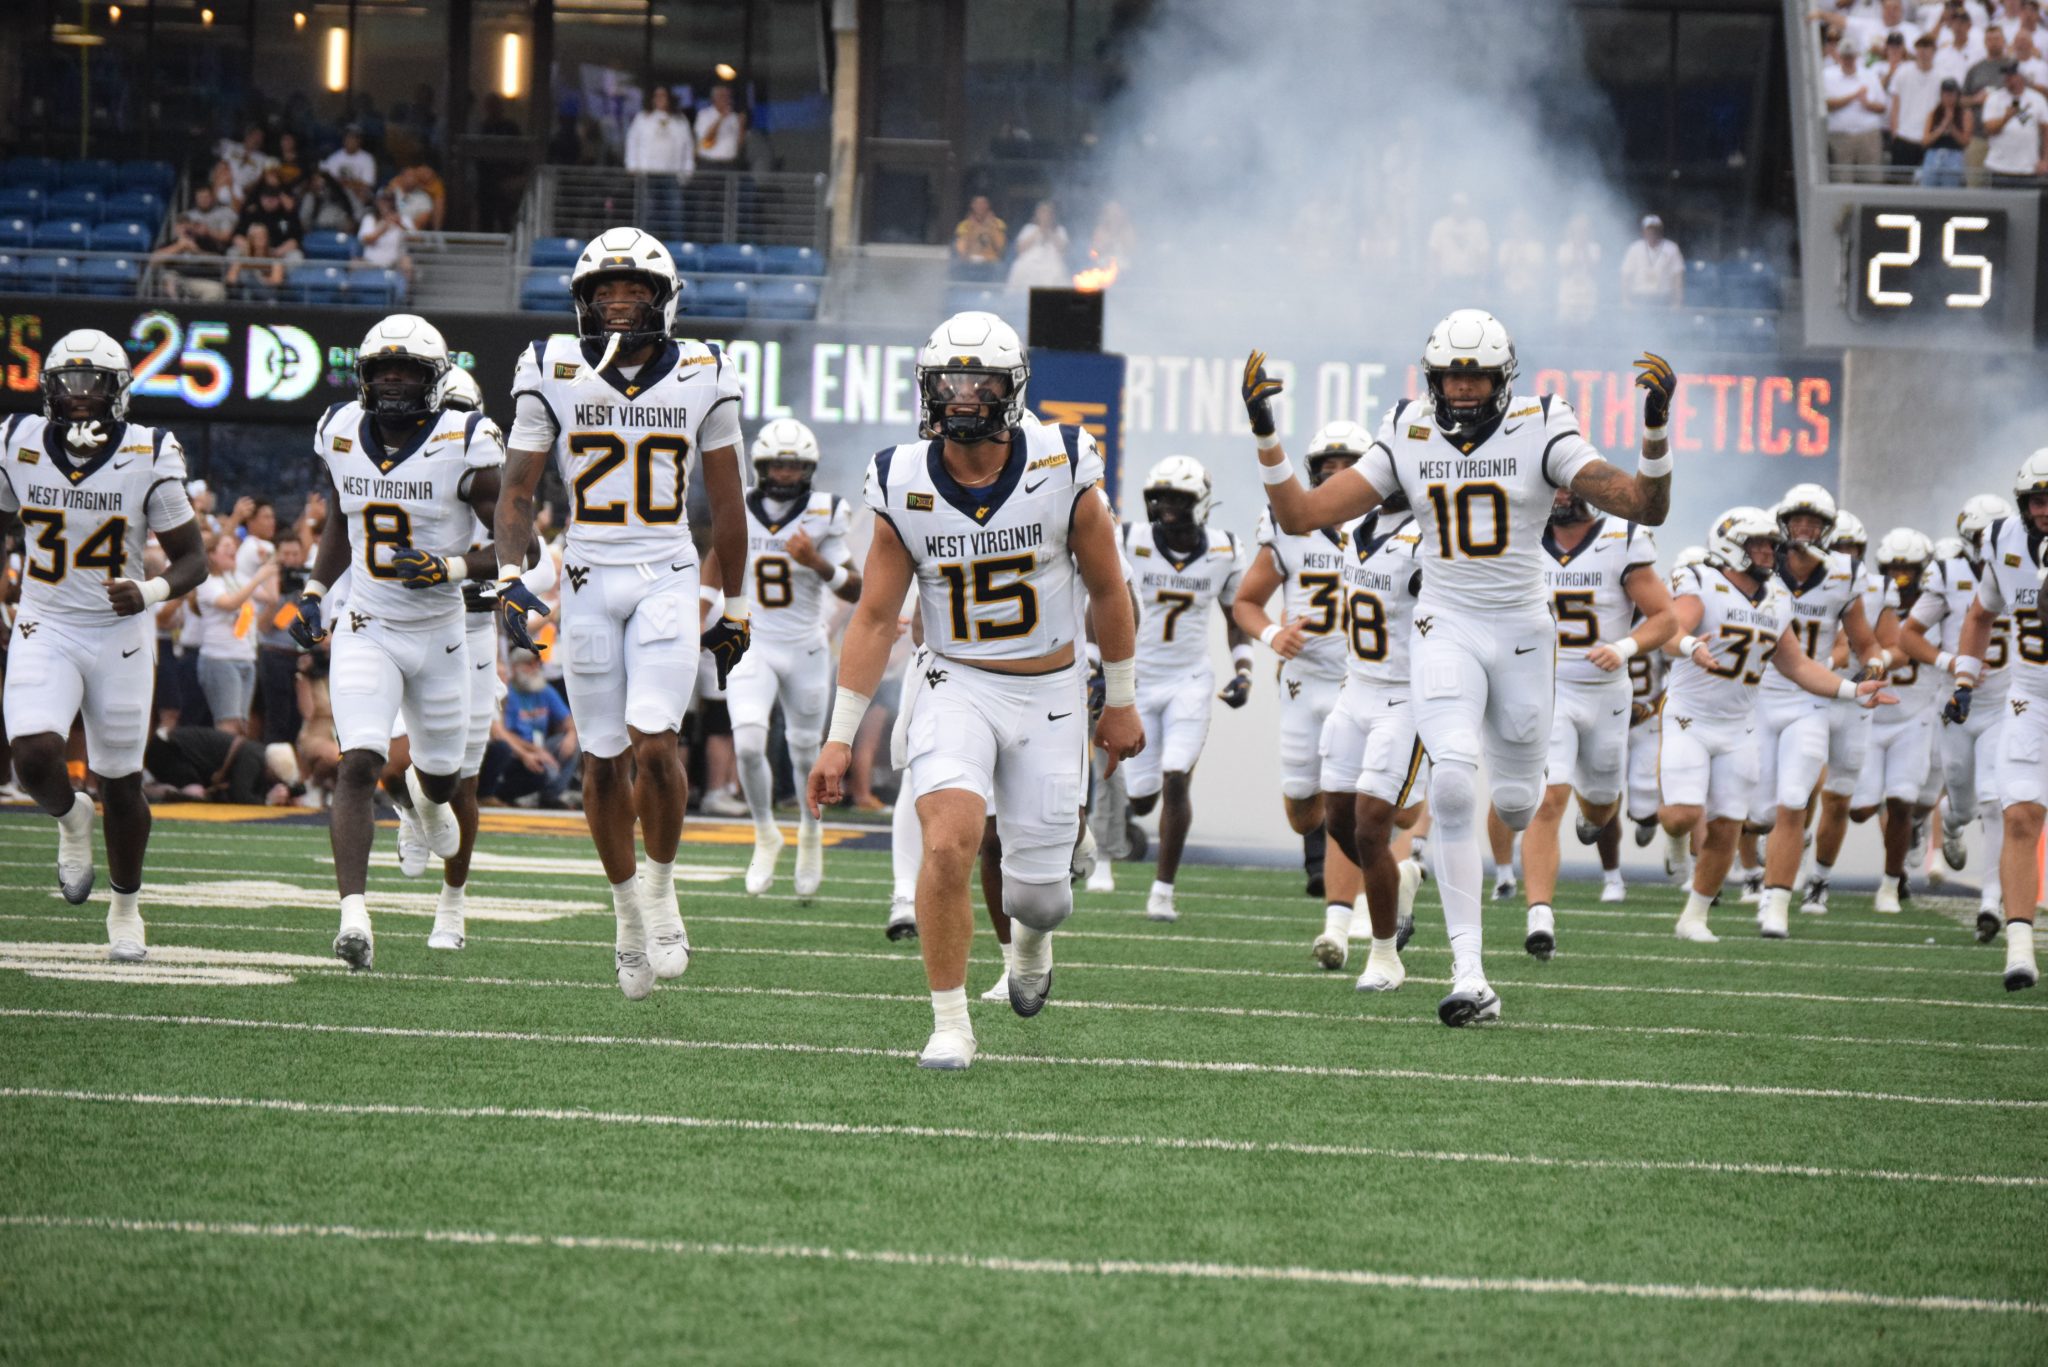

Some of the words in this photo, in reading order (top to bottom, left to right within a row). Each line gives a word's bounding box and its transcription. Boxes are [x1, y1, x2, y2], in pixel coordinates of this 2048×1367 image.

[1867, 213, 1992, 307] 25
[128, 308, 233, 408] 25
[574, 403, 614, 428] WEST
[619, 404, 688, 429] VIRGINIA
[1316, 362, 1386, 434] OF
[341, 474, 371, 497] WEST
[373, 478, 434, 501] VIRGINIA
[567, 430, 691, 527] 20
[1037, 452, 1067, 469] Antero
[1419, 460, 1453, 480] WEST
[1456, 457, 1518, 480] VIRGINIA
[27, 483, 61, 508] WEST
[62, 487, 123, 512] VIRGINIA
[1427, 480, 1511, 561] 10
[19, 505, 130, 587] 34
[362, 501, 414, 582] 8
[925, 533, 966, 559] WEST
[970, 522, 1043, 556] VIRGINIA
[1302, 551, 1332, 570] WEST
[754, 554, 794, 610] 8
[937, 550, 1041, 644] 15
[1142, 570, 1169, 588] WEST
[1170, 574, 1212, 592] VIRGINIA
[1354, 566, 1393, 593] VIRGINIA
[1555, 571, 1603, 587] VIRGINIA
[1156, 589, 1196, 643] 7
[1349, 588, 1389, 663] 8
